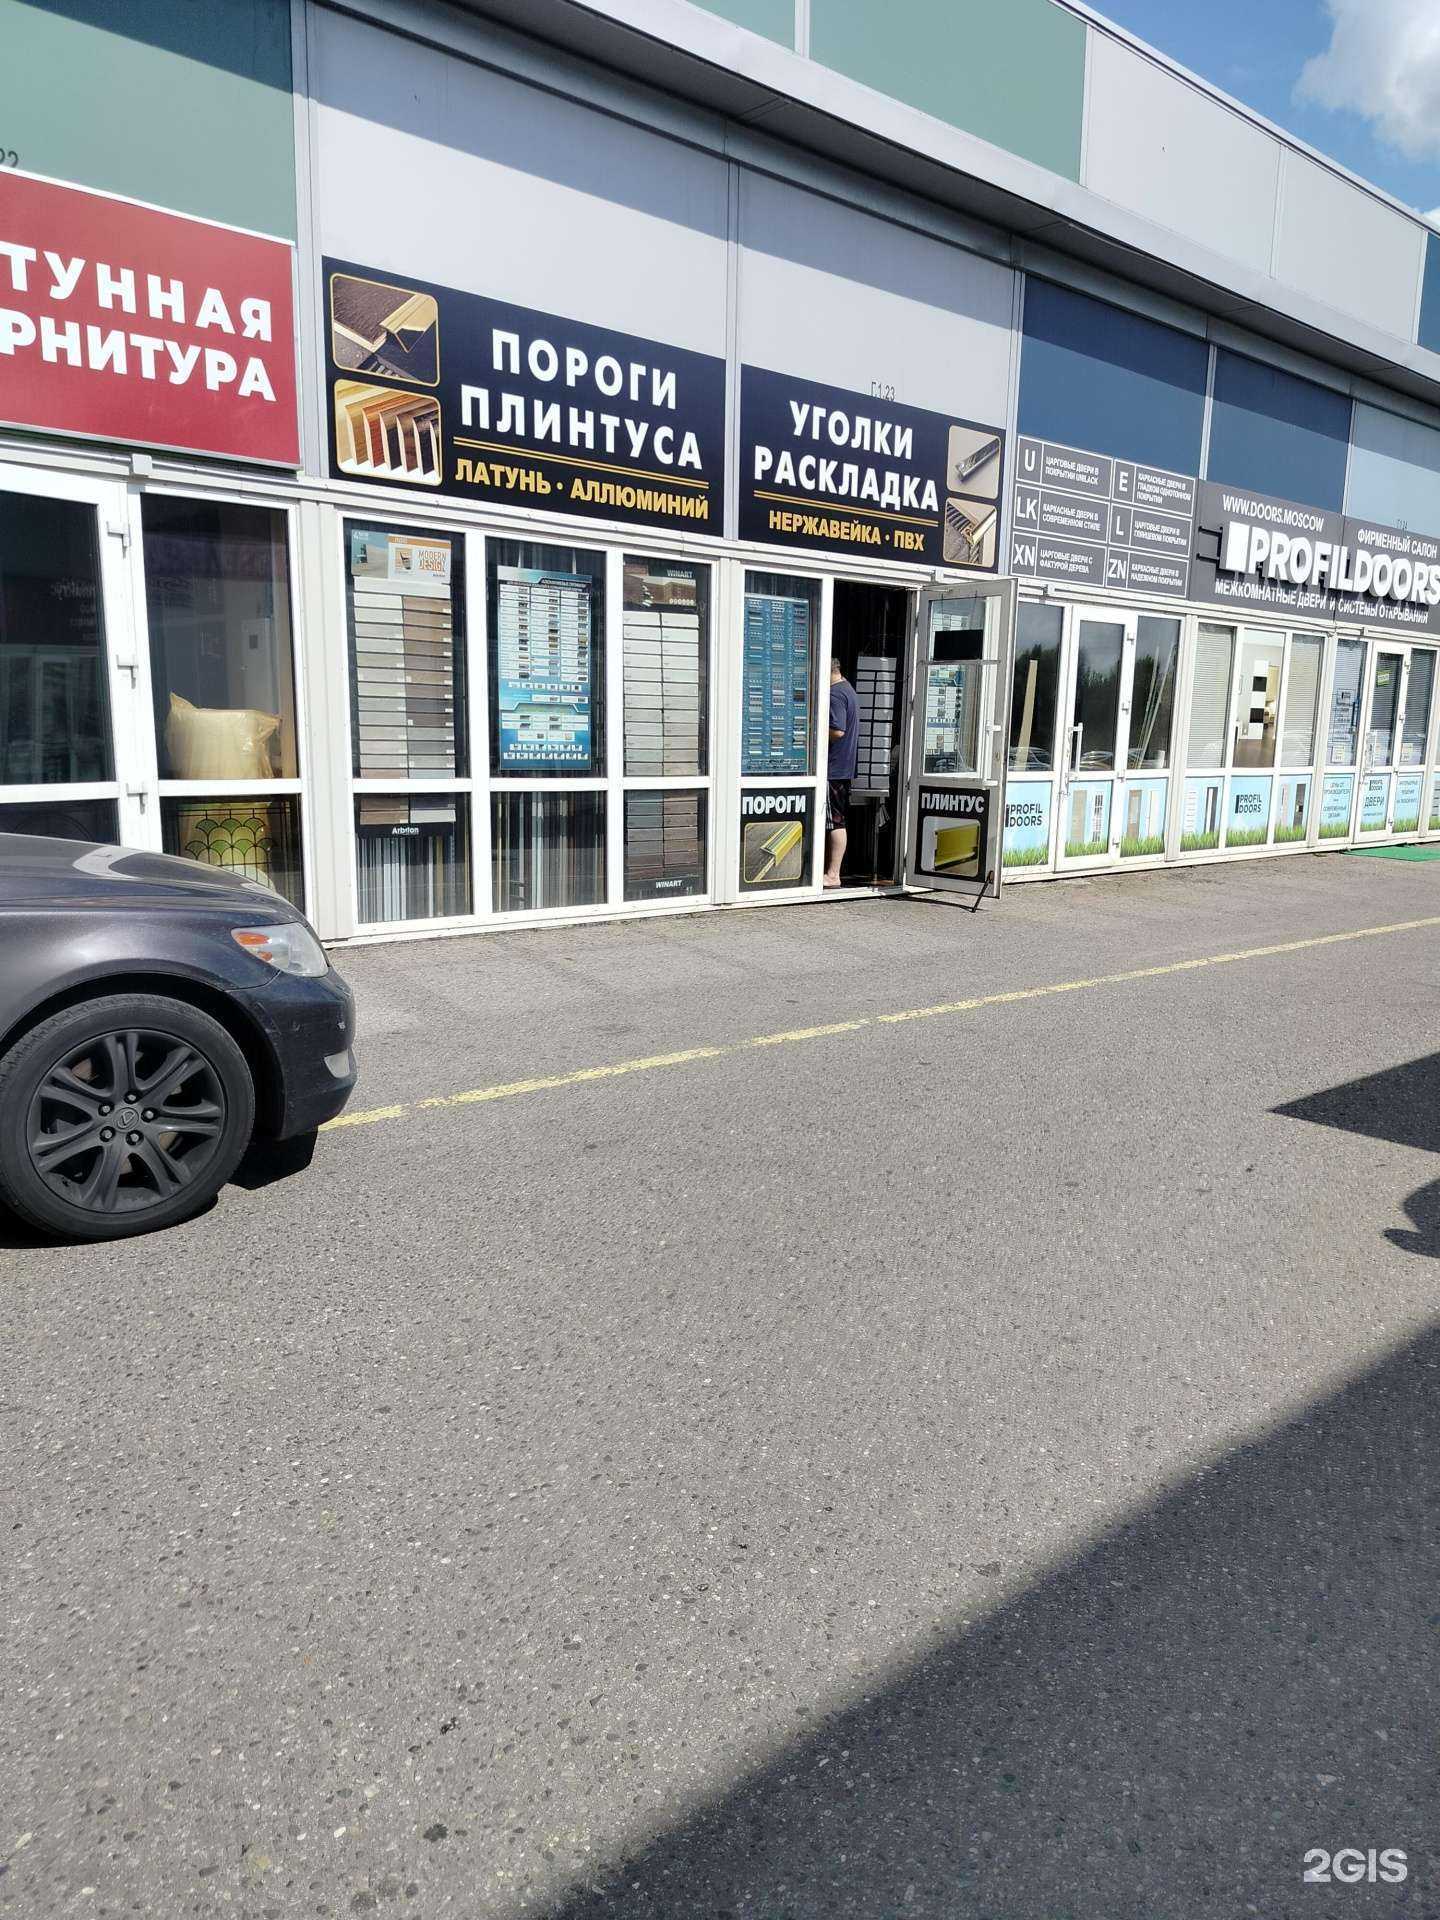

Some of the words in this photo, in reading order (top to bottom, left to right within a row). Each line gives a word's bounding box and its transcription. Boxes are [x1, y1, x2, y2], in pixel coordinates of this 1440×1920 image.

[0, 240, 272, 342] ТУННАЯ
[492, 328, 677, 410] ПОРОГИ
[460, 384, 702, 469] ПЛИНТУСА
[789, 400, 913, 460] УГОЛКИ
[1024, 449, 1036, 472] U
[455, 458, 551, 495] ЛАТУНЬ
[570, 478, 709, 520] АЛЛЮМИНИЙ
[754, 445, 939, 512] РАСКЛАДКА
[1118, 471, 1129, 492] E
[1016, 496, 1037, 520] LK
[1222, 494, 1325, 532] WWW.DOORS.MOSCOW
[769, 510, 881, 545] НЕРЖАВЕЙКА
[893, 530, 925, 552] ПВХ
[1115, 516, 1124, 536] L
[1013, 543, 1036, 567] XN
[1357, 528, 1411, 553] ФИРМЕННЫЙ
[1411, 540, 1438, 558] САЛОН
[1107, 558, 1127, 580] ZN
[1248, 526, 1440, 606] PROFILDOORS
[1296, 591, 1328, 610] ДВЕРИ
[1338, 598, 1378, 617] СИСТЕМЫ
[742, 795, 806, 814] ПОРОГИ
[921, 793, 985, 813] ПЛИНТУС
[1010, 803, 1043, 815] PROFIL
[1239, 804, 1262, 813] DOORS
[1240, 794, 1262, 803] PROFIL
[1009, 816, 1042, 827] DOORS
